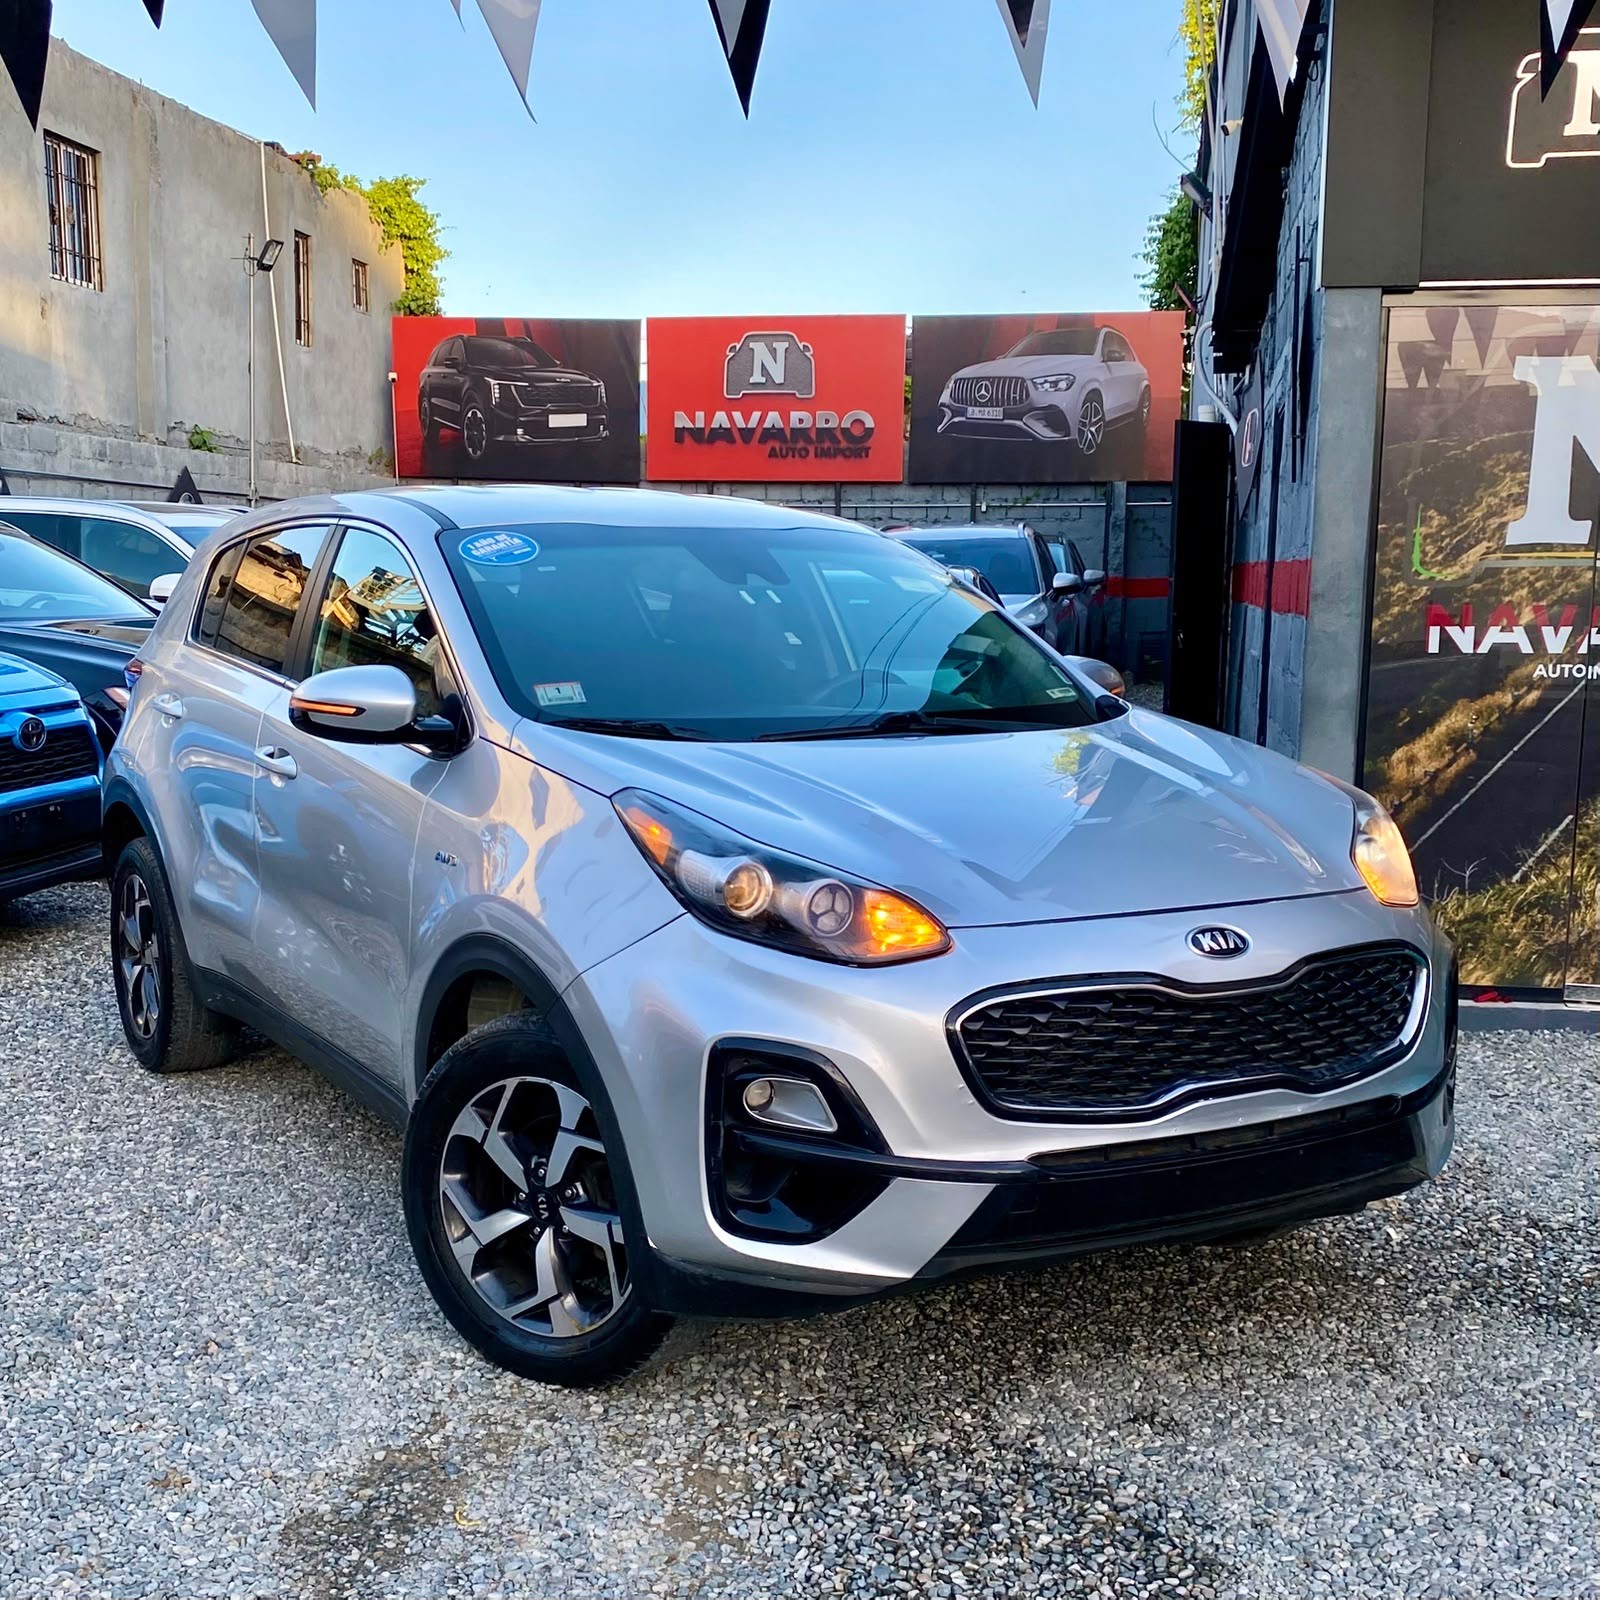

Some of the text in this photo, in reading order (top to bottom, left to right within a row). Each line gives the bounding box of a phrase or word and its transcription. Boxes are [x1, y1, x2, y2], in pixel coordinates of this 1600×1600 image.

[750, 341, 789, 384] N
[674, 410, 875, 445] NAVARRO
[768, 446, 871, 459] AUTO IMPORT
[1195, 930, 1244, 952] KIA
[537, 1193, 549, 1220] KIA
